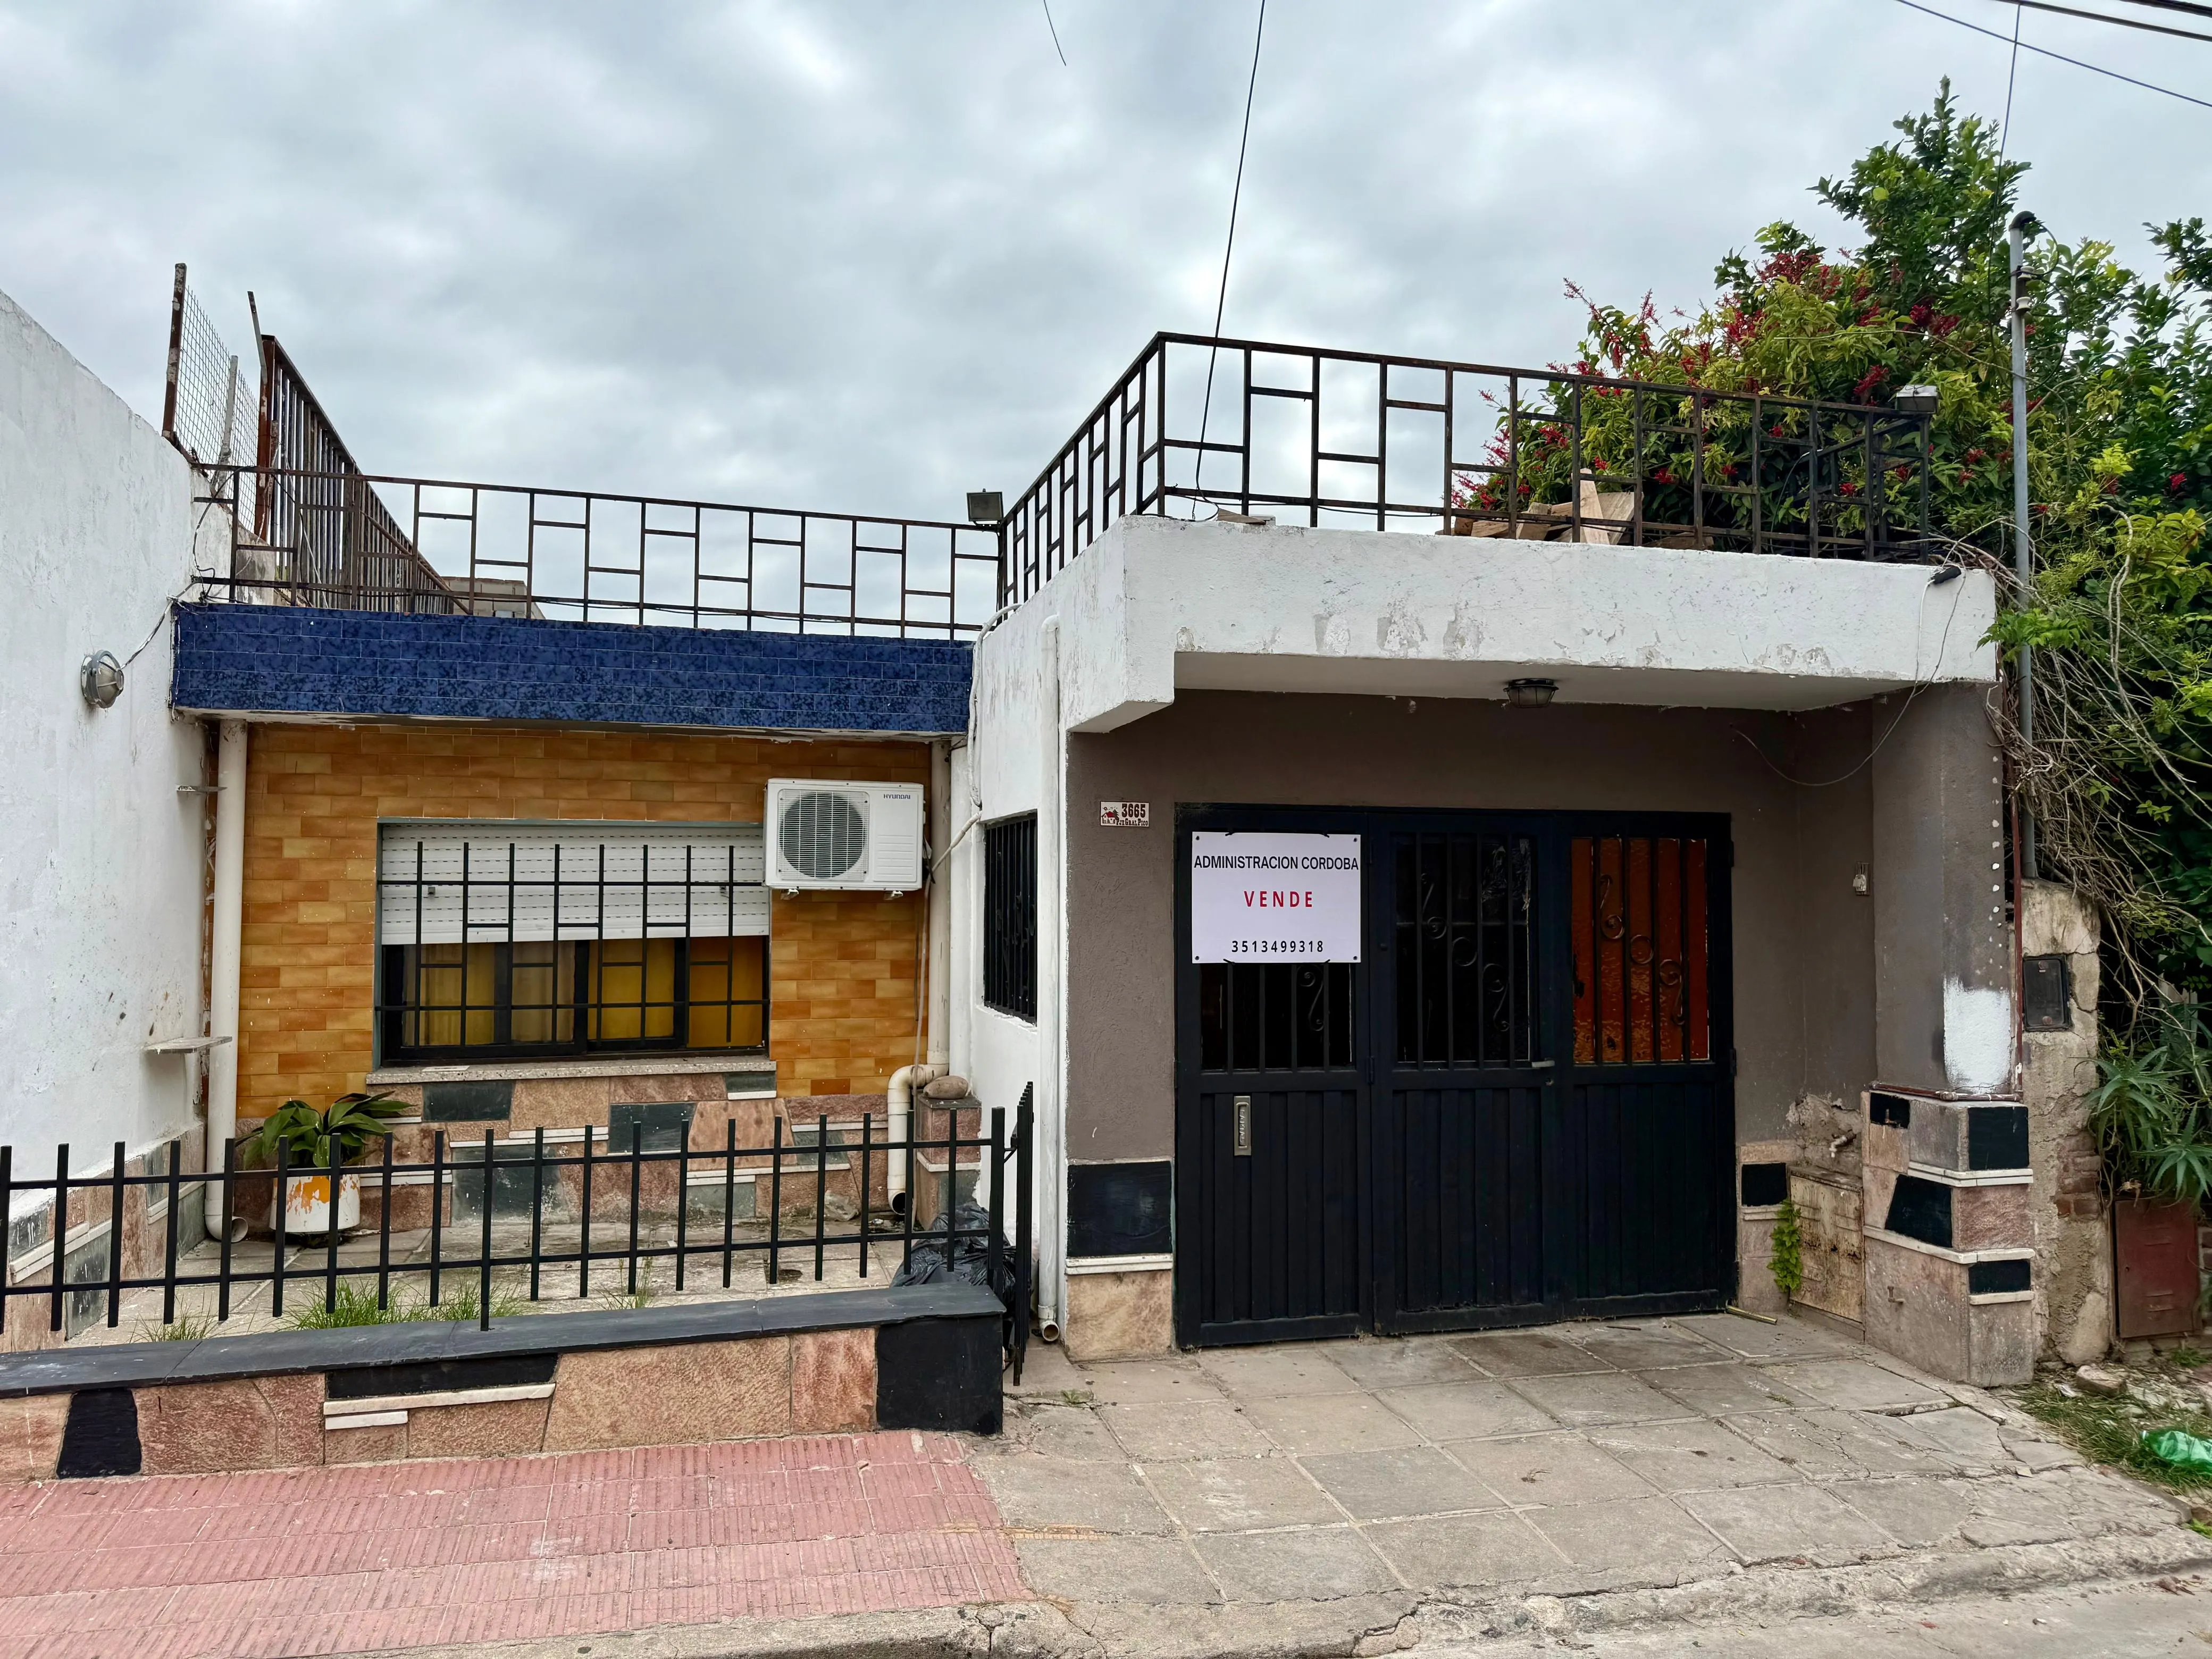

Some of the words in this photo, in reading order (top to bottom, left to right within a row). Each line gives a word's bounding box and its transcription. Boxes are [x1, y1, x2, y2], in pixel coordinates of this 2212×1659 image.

[1121, 803, 1146, 818] 3665
[1194, 855, 1298, 869] ADMINISTRACION
[1301, 857, 1359, 870] CORDOBA
[1244, 891, 1313, 908] VENDE
[1231, 940, 1323, 952] 3513499318
